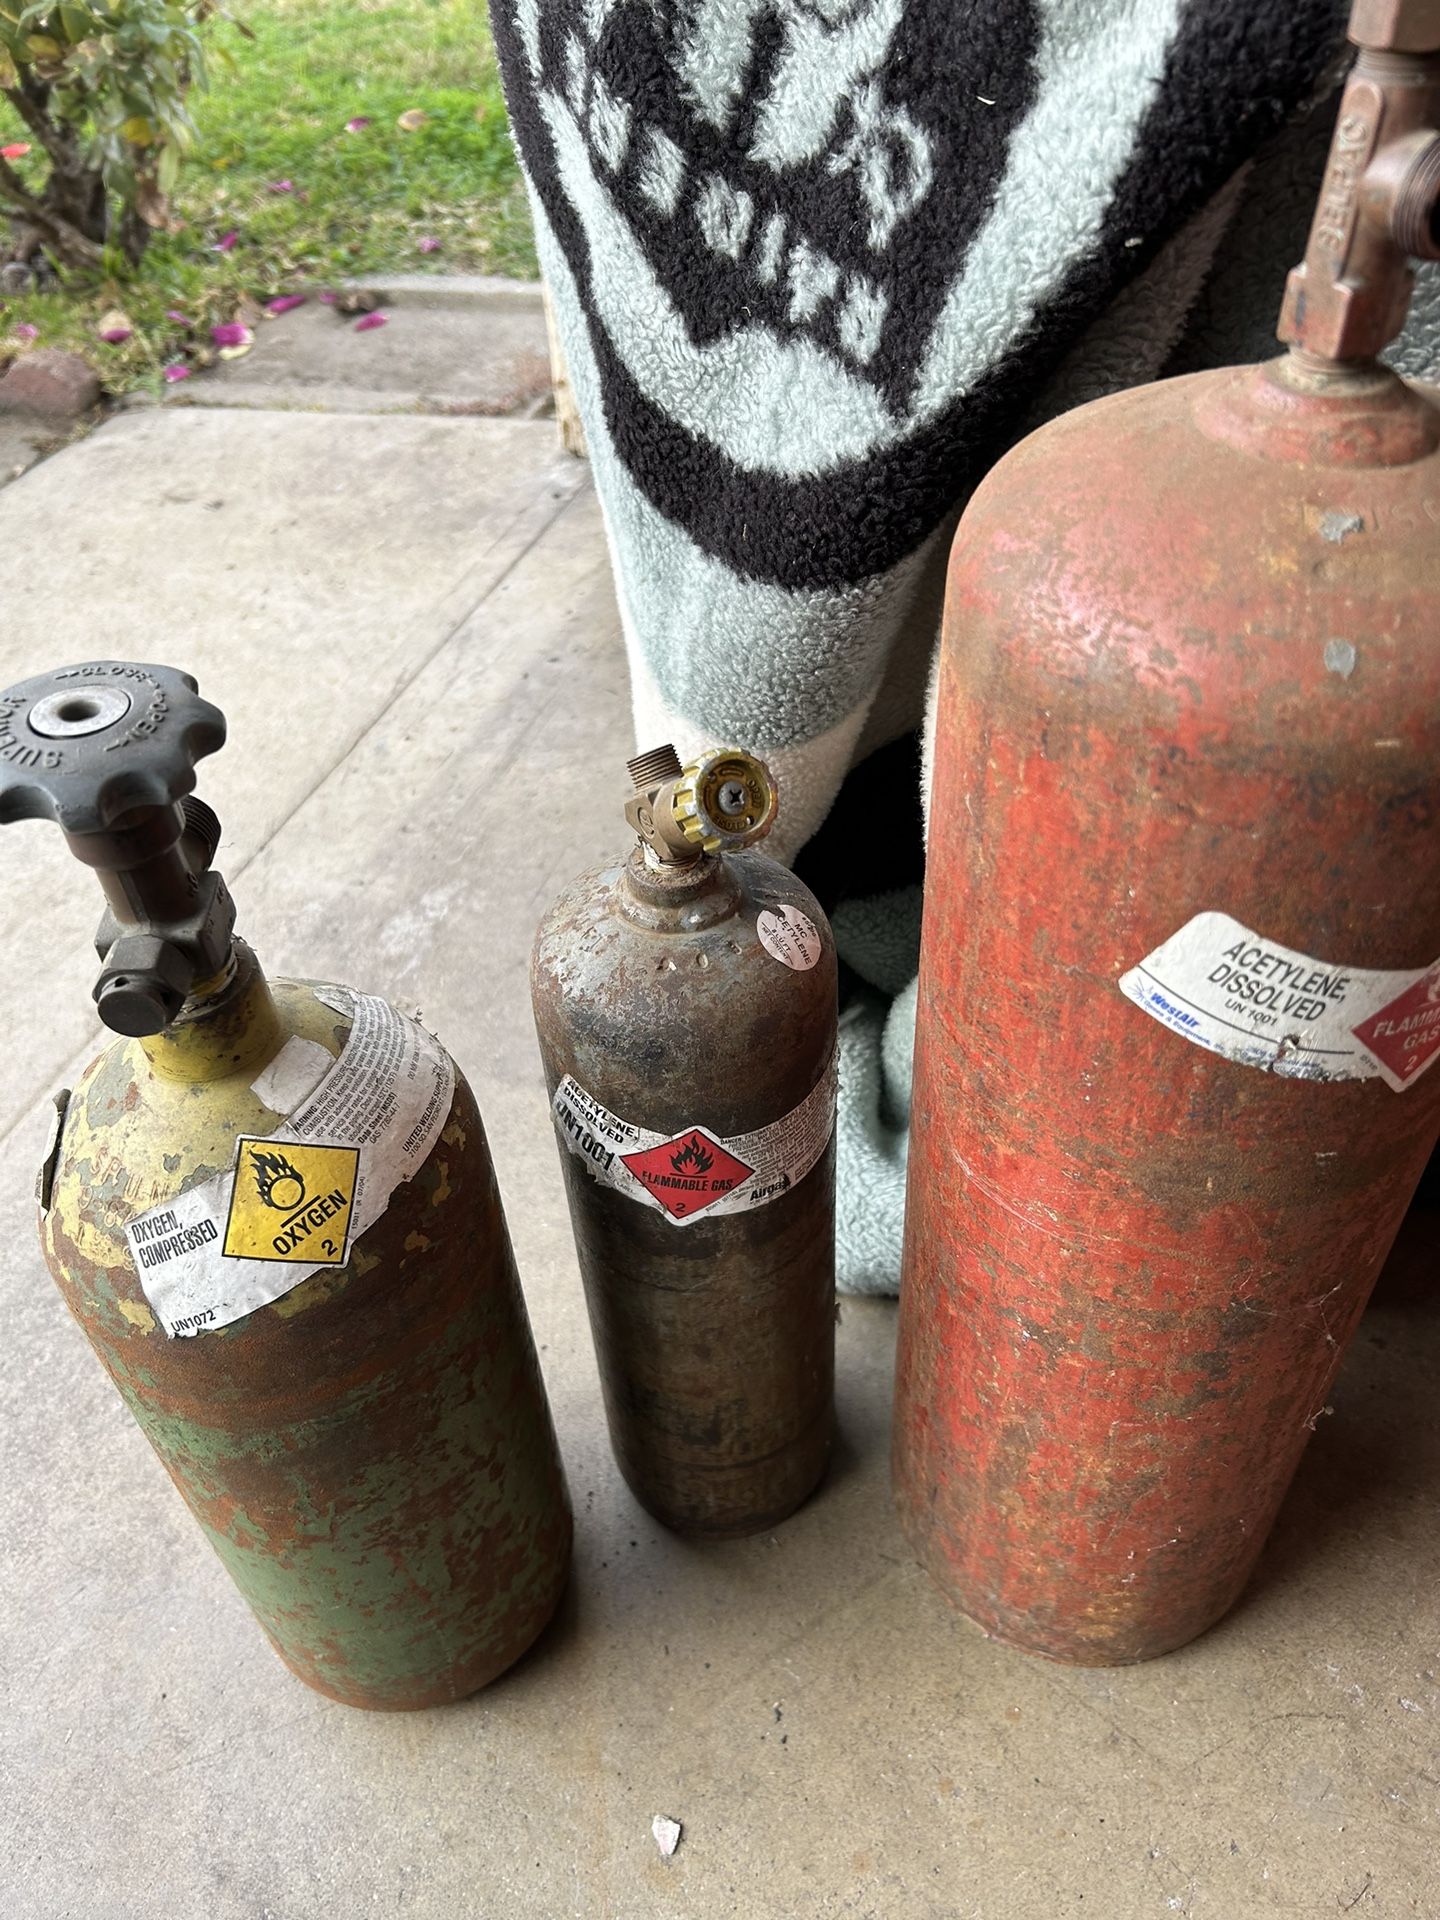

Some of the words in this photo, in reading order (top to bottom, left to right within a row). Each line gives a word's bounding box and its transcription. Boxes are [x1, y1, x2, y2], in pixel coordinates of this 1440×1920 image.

[776, 913, 812, 965] CETYLENE
[794, 922, 808, 939] MC
[1222, 941, 1352, 1003] ACETYLENE,
[1150, 992, 1199, 1028] WestAir
[1208, 963, 1326, 1021] DISSOLVED
[1225, 999, 1247, 1014] UN
[1250, 1009, 1278, 1026] 1001
[1373, 1008, 1440, 1038] FLAMM
[1404, 1055, 1418, 1071] 2
[315, 1090, 330, 1105] HIGH
[326, 1064, 349, 1091] PRESSURE
[335, 1082, 349, 1096] Keep
[344, 1075, 353, 1083] oil
[314, 1126, 325, 1137] use
[322, 1114, 335, 1127] with
[332, 1092, 352, 1116] adequate
[327, 1118, 346, 1137] service
[342, 1107, 353, 1119] and
[350, 1094, 362, 1108] rated
[358, 1086, 368, 1095] for
[340, 1124, 350, 1135] the
[347, 1123, 364, 1141] should
[361, 1114, 371, 1125] not
[357, 1128, 371, 1144] Data
[368, 1111, 383, 1129] Sheet
[378, 1091, 397, 1114] (MSDS)
[401, 1123, 423, 1152] UNITED
[417, 1096, 438, 1126] WELDING
[564, 1087, 624, 1143] DISSOLVED
[408, 1142, 421, 1158] 2100
[422, 1119, 434, 1134] SAN
[556, 1101, 615, 1170] UN1001
[642, 1171, 709, 1191] FLAMMABLE
[711, 1178, 734, 1192] GAS
[272, 1189, 348, 1255] OXYGEN
[675, 1202, 686, 1212] 2
[131, 1210, 183, 1244] OXYGEN,
[138, 1219, 218, 1269] COMPRESSED
[321, 1239, 338, 1257] 2
[170, 1309, 217, 1332] UN1072
